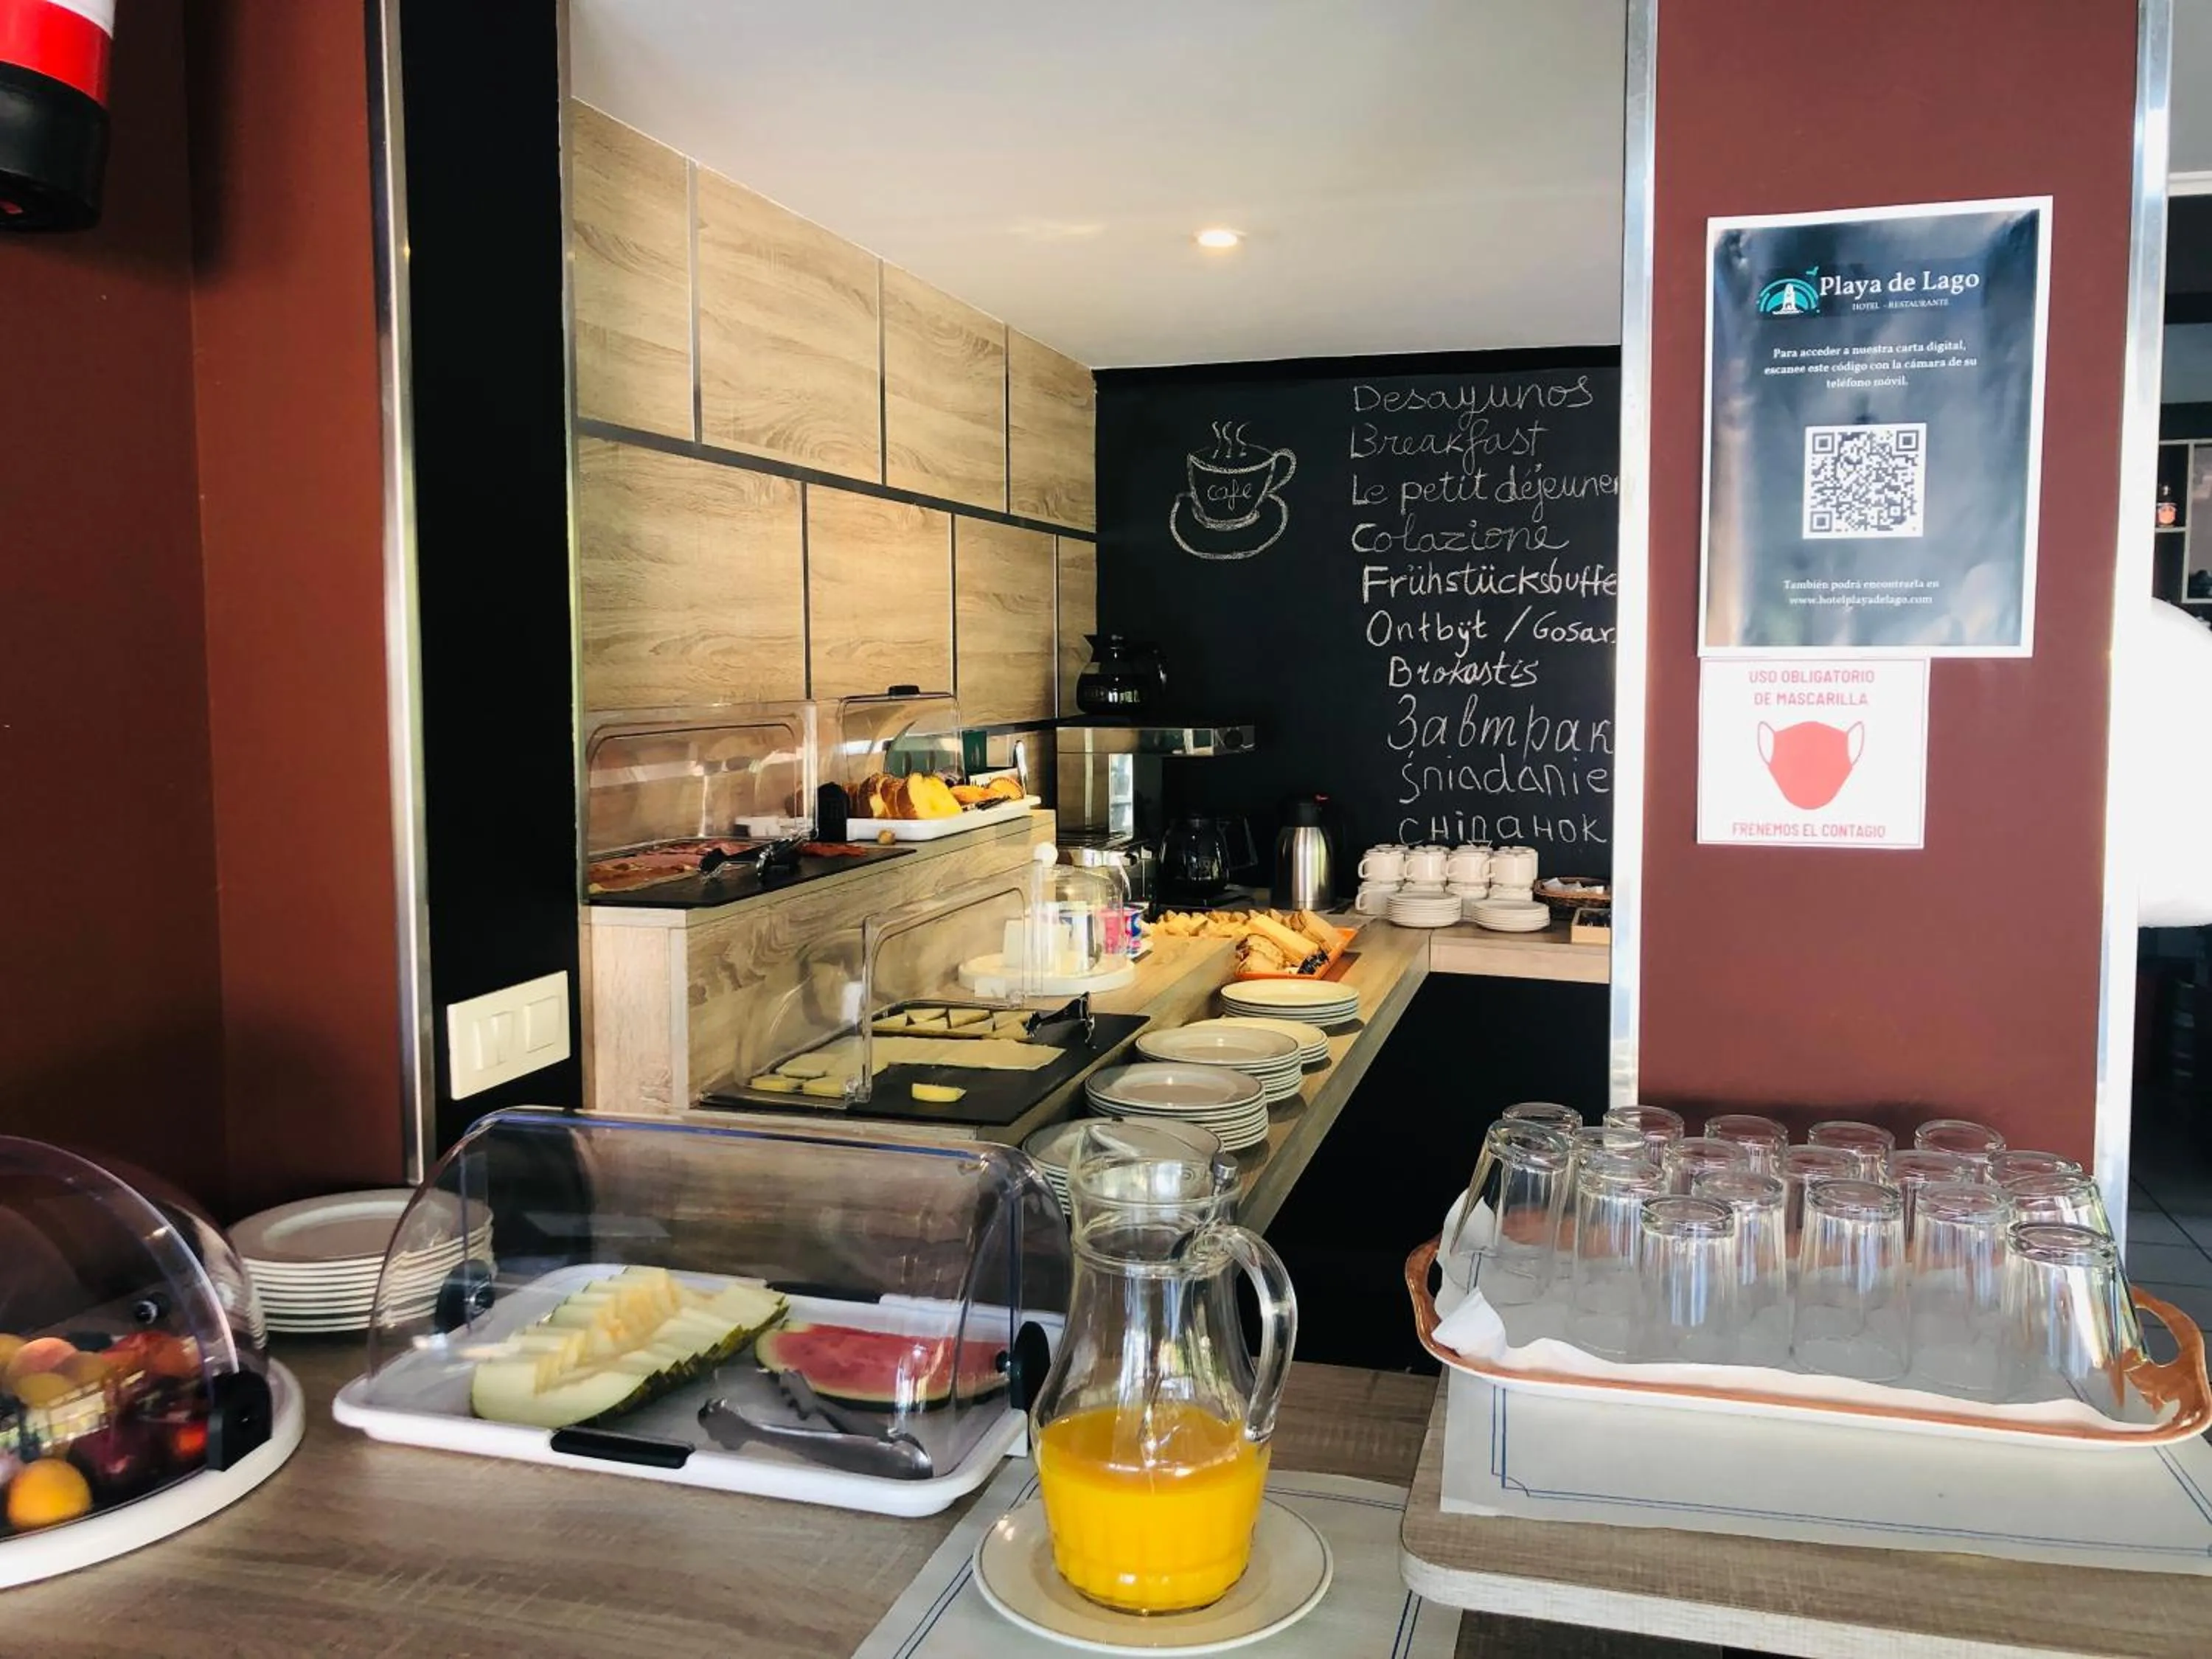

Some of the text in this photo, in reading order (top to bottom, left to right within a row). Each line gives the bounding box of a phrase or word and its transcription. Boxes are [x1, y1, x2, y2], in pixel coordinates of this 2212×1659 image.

[1820, 271, 1980, 299] Playa de Lago
[1852, 302, 1879, 310] HOTEL
[1888, 299, 1949, 308] RESTAURANTE
[1773, 348, 1798, 358] Para
[1800, 346, 1841, 357] acceder
[1851, 344, 1893, 355] nuestra
[1896, 344, 1924, 352] carta
[1927, 339, 1966, 353] digital,
[1764, 356, 1977, 375] escanee este código con la cámara de su
[1826, 377, 1871, 389] teléfono
[1353, 375, 1593, 431] Desayunos
[1350, 418, 1549, 475] Breakfast
[1352, 474, 1388, 506] Le
[1402, 467, 1489, 516] petit
[1352, 514, 1570, 553] Colazione
[1783, 579, 1939, 591] También podrá encontrarla en
[1789, 594, 1933, 606] www.hotelplayadelago.com
[1388, 651, 1540, 688] Brokastis
[1749, 669, 1875, 684] USO OBLIGATORIO
[1754, 692, 1868, 706] DE MASCARILLA
[1733, 822, 1886, 838] FRENEMOS EL CONTAGIO
